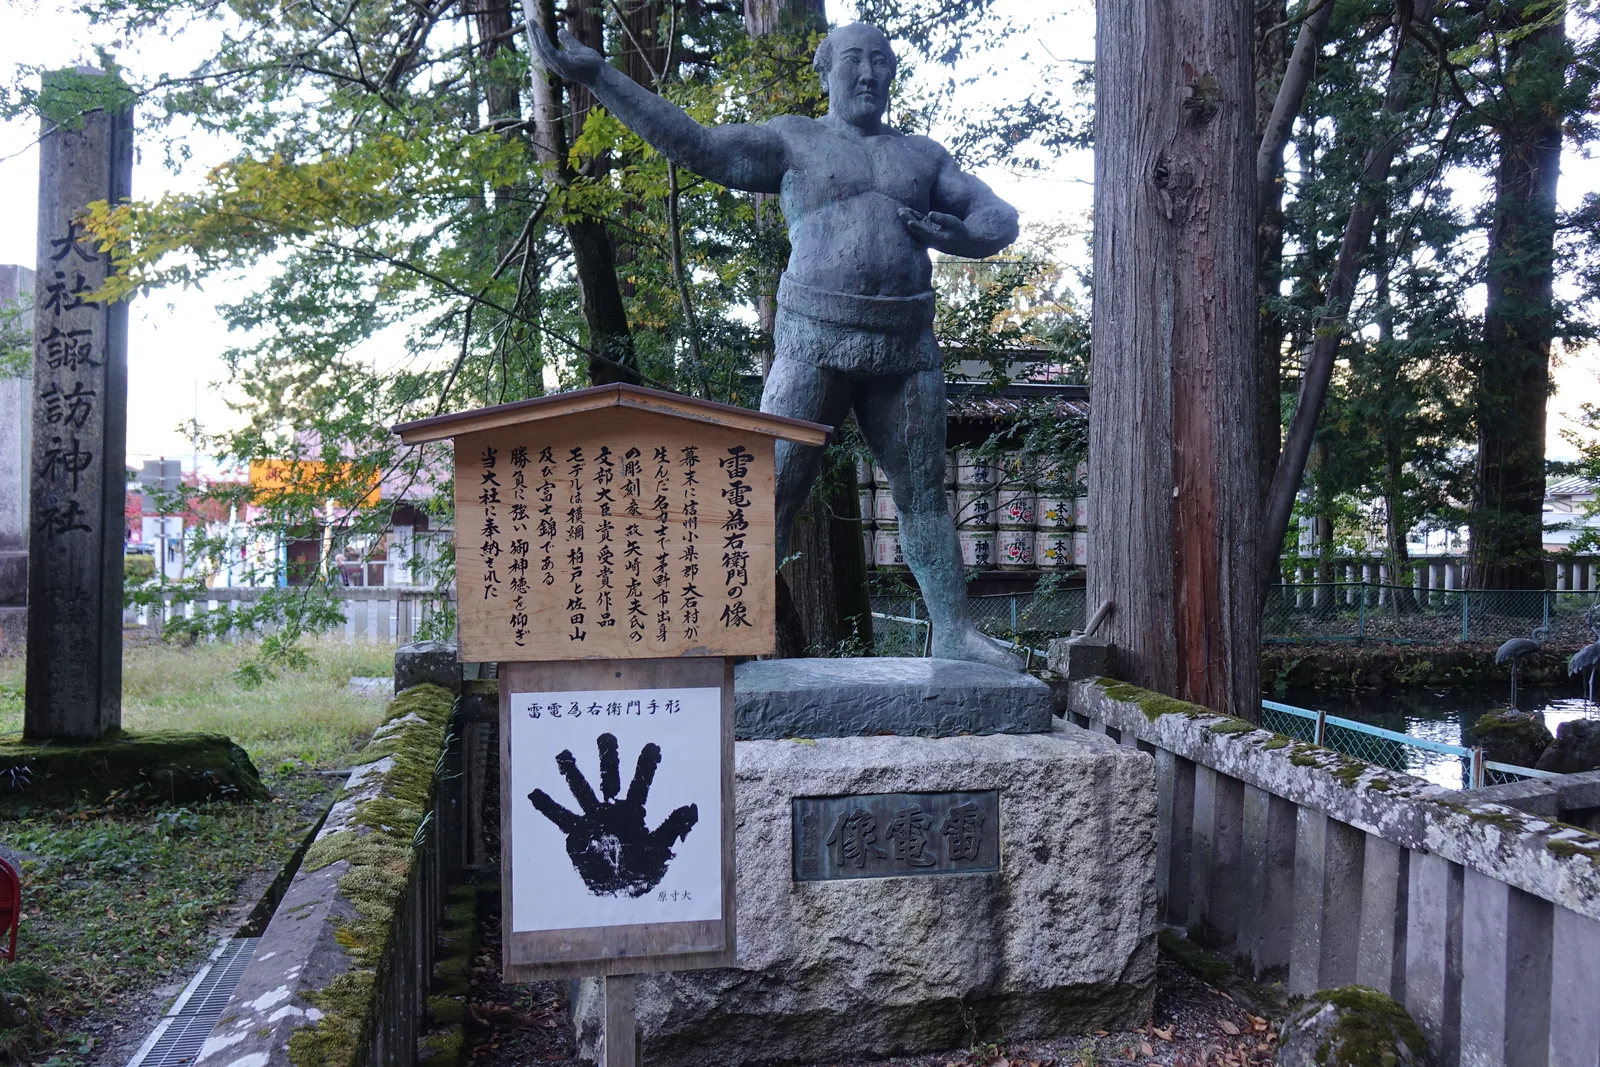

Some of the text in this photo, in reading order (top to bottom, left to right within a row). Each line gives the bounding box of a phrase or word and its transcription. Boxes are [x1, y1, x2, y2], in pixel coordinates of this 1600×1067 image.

[479, 446, 504, 600] 当大社に奉納された
[593, 446, 616, 627] 文部大臣賞受賞作品
[651, 446, 671, 642] 生んだ名力士で茅野市出身
[678, 445, 704, 640] 幕末に信州小県郡大石村が
[719, 445, 755, 627] 雷電為右衛門の像
[1053, 540, 1067, 565] 本金
[1054, 502, 1068, 527] 本金
[657, 890, 692, 902] 原寸大
